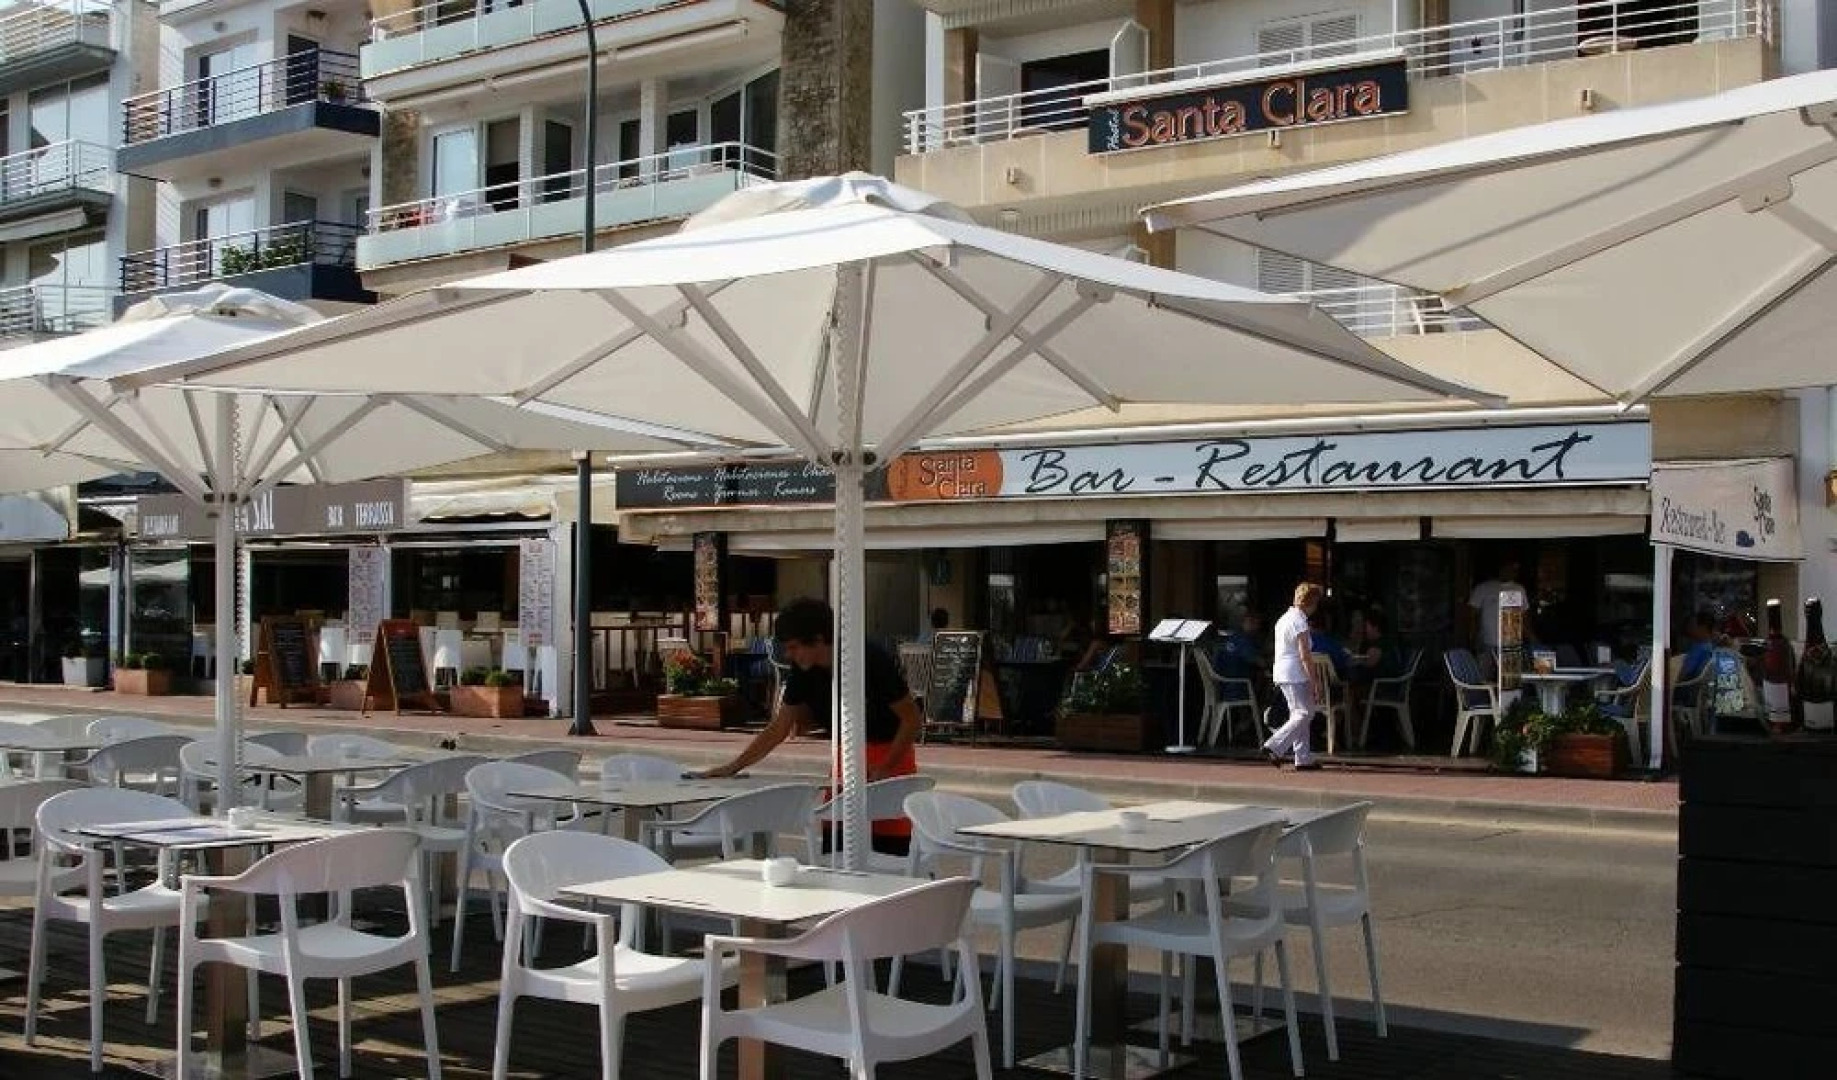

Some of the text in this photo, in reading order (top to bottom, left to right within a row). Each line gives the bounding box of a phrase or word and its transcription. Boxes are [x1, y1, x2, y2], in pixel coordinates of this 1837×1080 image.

[1121, 78, 1382, 147] Santa Clara
[920, 455, 985, 499] Santa Clara
[1020, 449, 1137, 494] Bar
[1195, 431, 1593, 490] Restaurant
